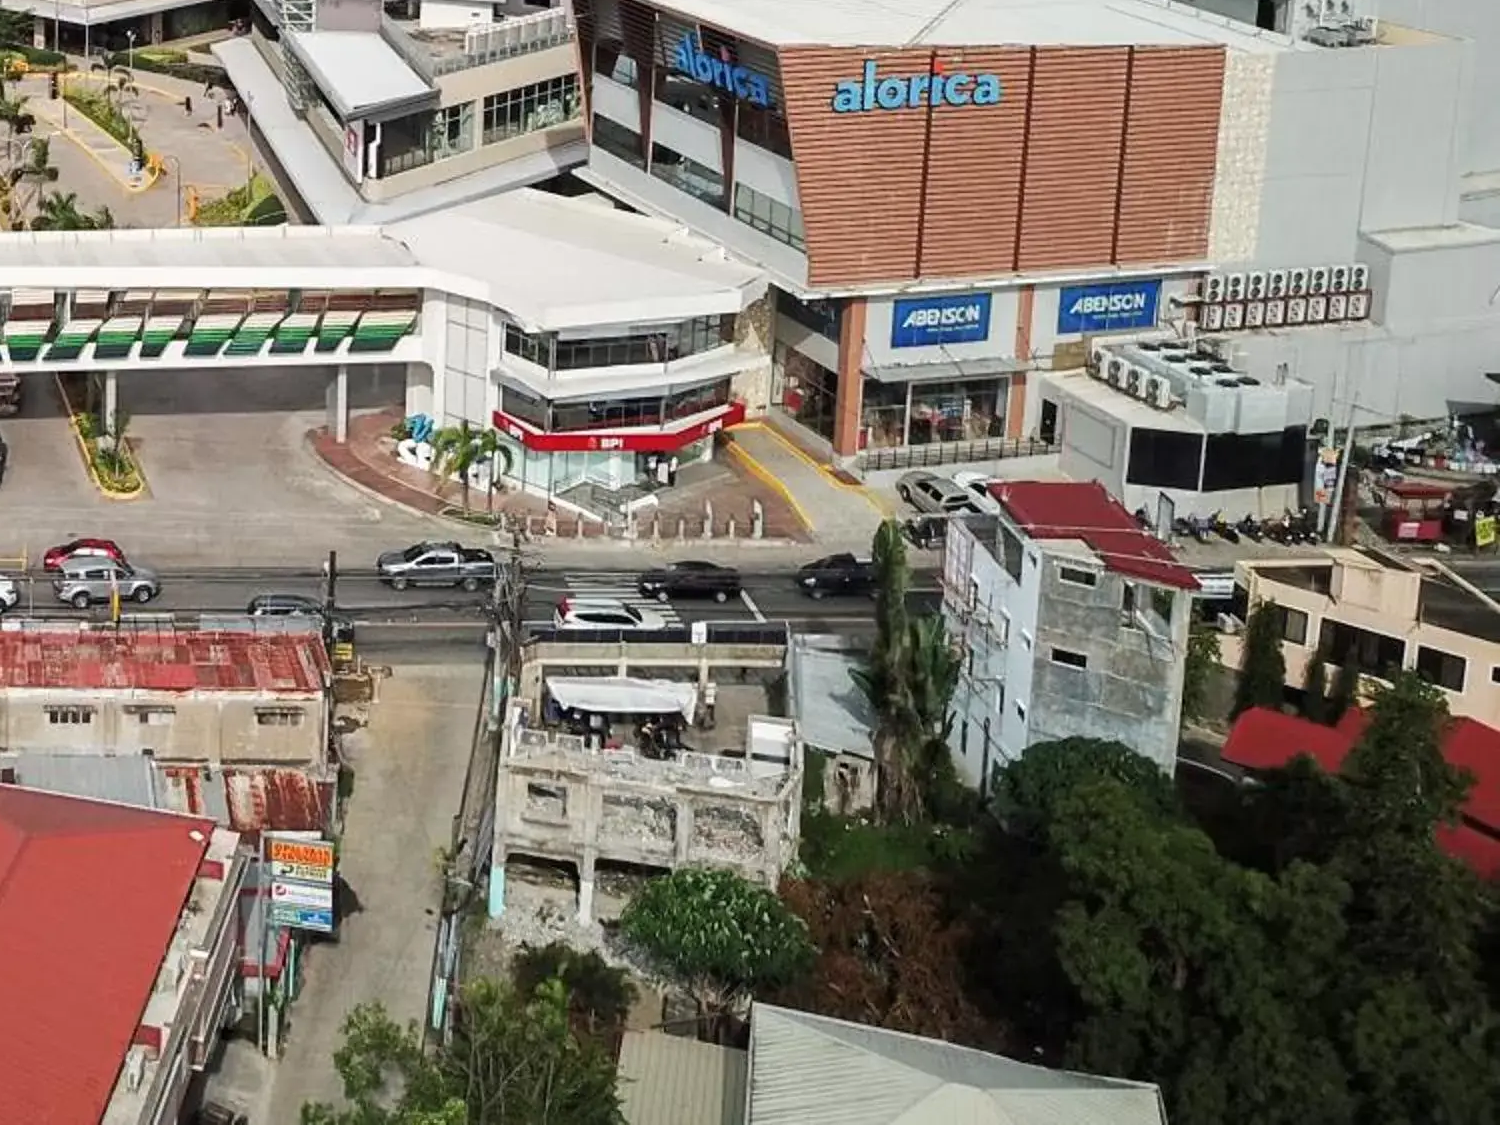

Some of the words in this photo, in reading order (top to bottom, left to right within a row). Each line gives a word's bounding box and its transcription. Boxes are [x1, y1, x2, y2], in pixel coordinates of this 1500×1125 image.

[675, 33, 769, 107] alorica
[832, 60, 1000, 113] alorica
[1070, 293, 1145, 314] ABENSON
[902, 304, 981, 327] ABENSON
[601, 438, 624, 448] BPI
